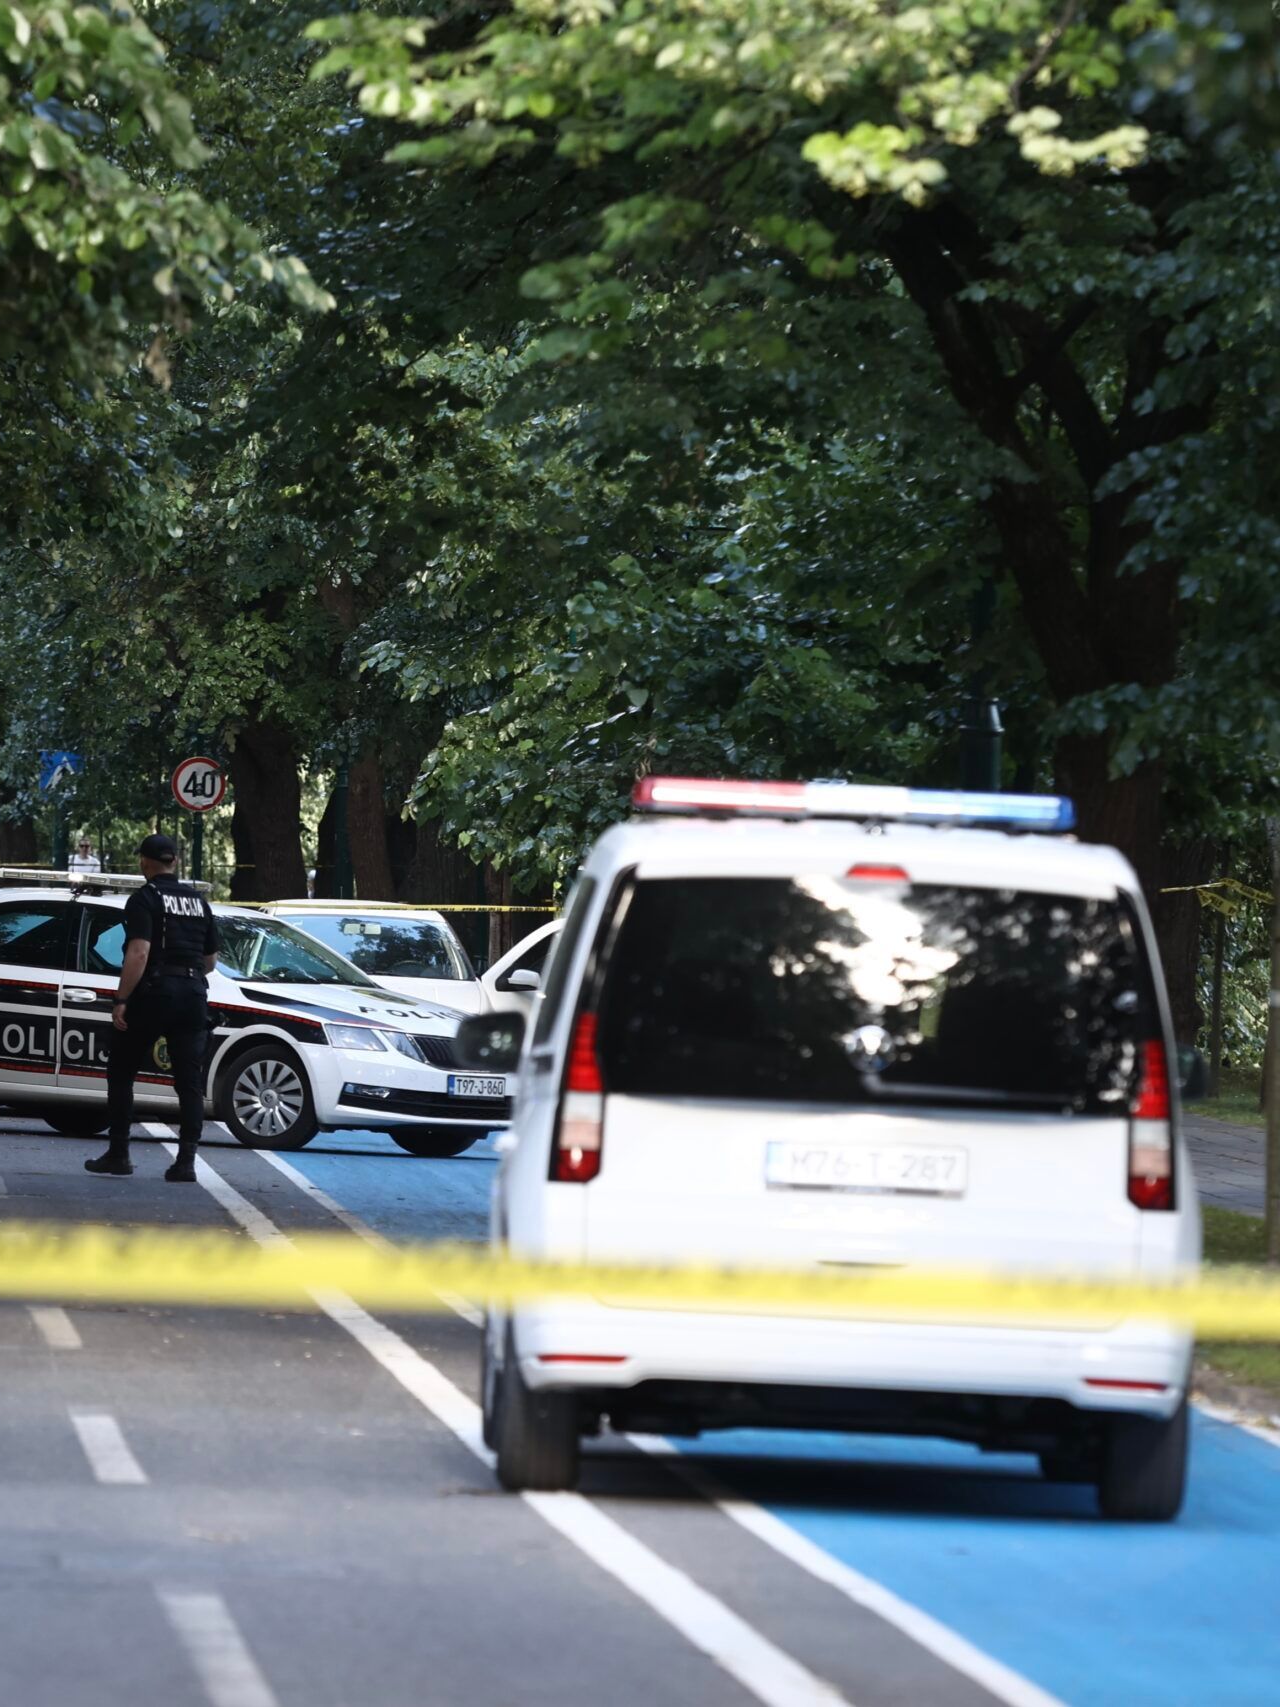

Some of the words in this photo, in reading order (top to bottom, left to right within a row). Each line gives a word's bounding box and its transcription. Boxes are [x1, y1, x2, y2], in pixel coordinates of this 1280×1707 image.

[183, 771, 215, 798] 40
[163, 894, 204, 917] POLICIJA
[456, 1078, 504, 1095] T97-J-860
[791, 1150, 958, 1181] M76-T-287
